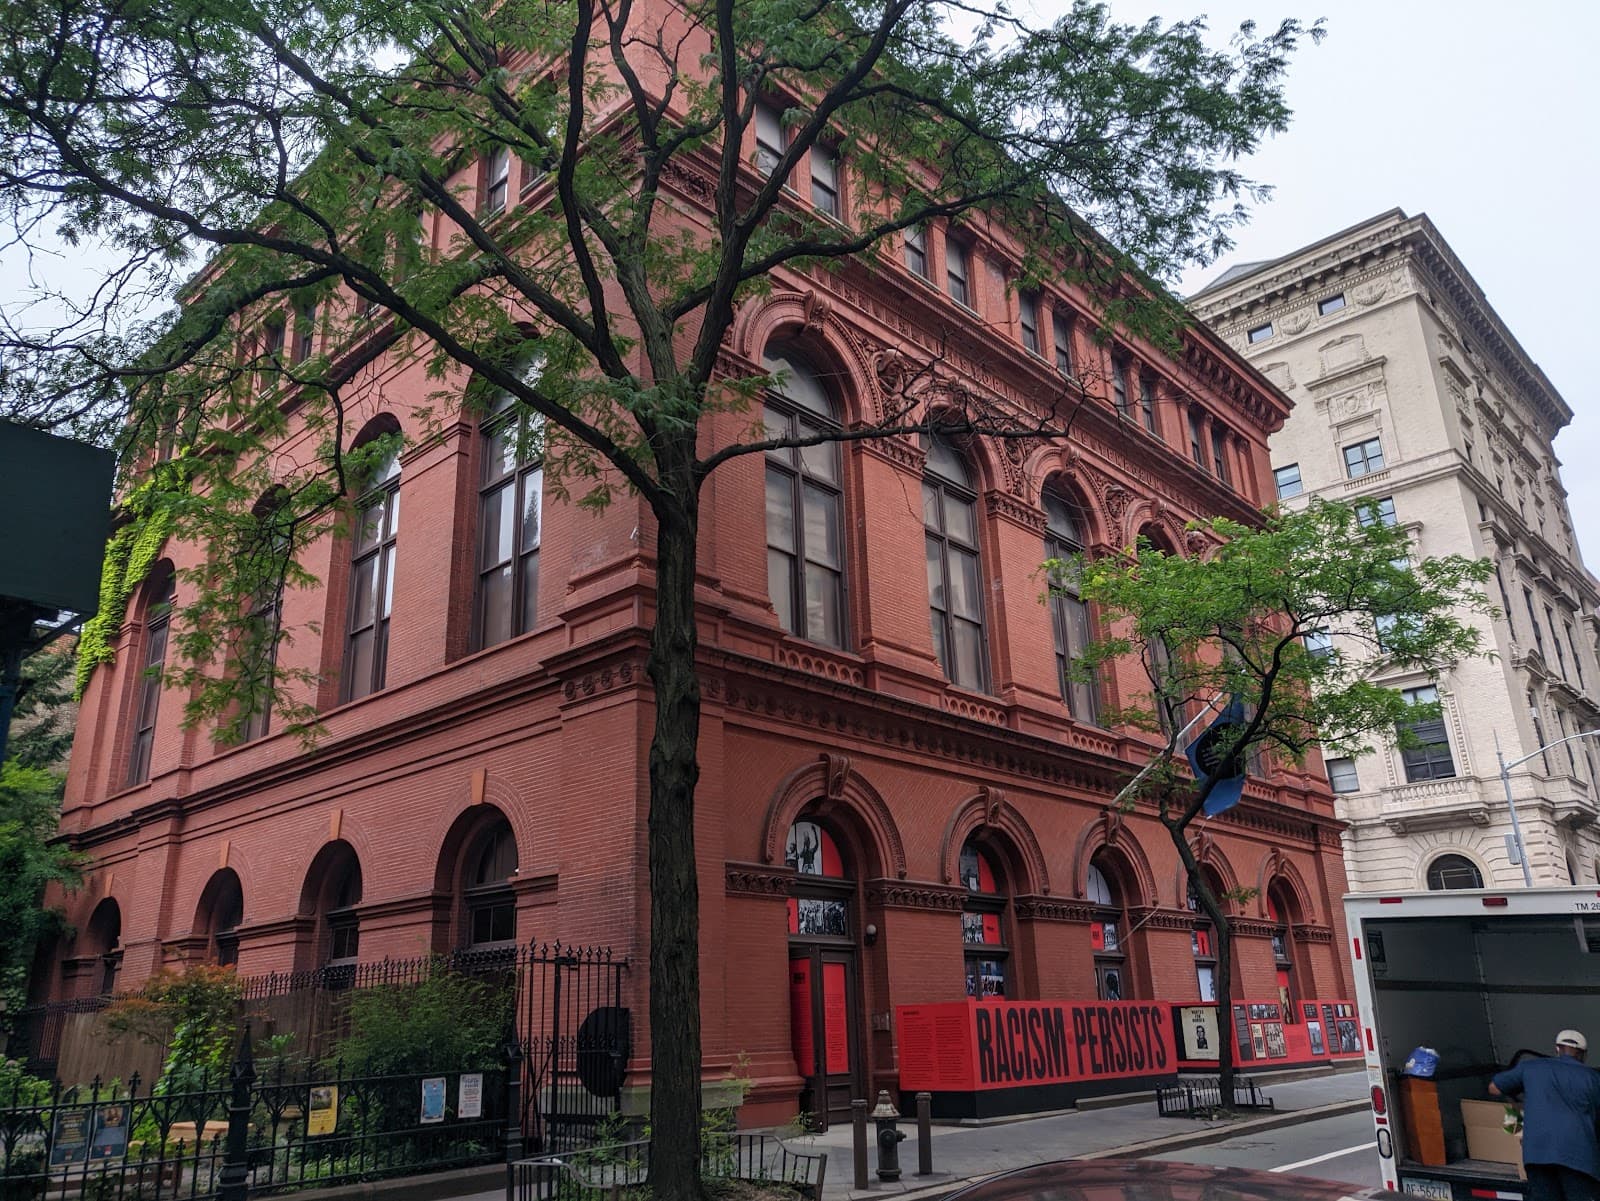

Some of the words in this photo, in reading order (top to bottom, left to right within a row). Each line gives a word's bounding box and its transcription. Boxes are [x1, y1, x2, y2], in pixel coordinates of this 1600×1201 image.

[1575, 902, 1589, 911] TM
[976, 1007, 1069, 1083] RACISM
[1072, 1006, 1167, 1075] PERSISTS
